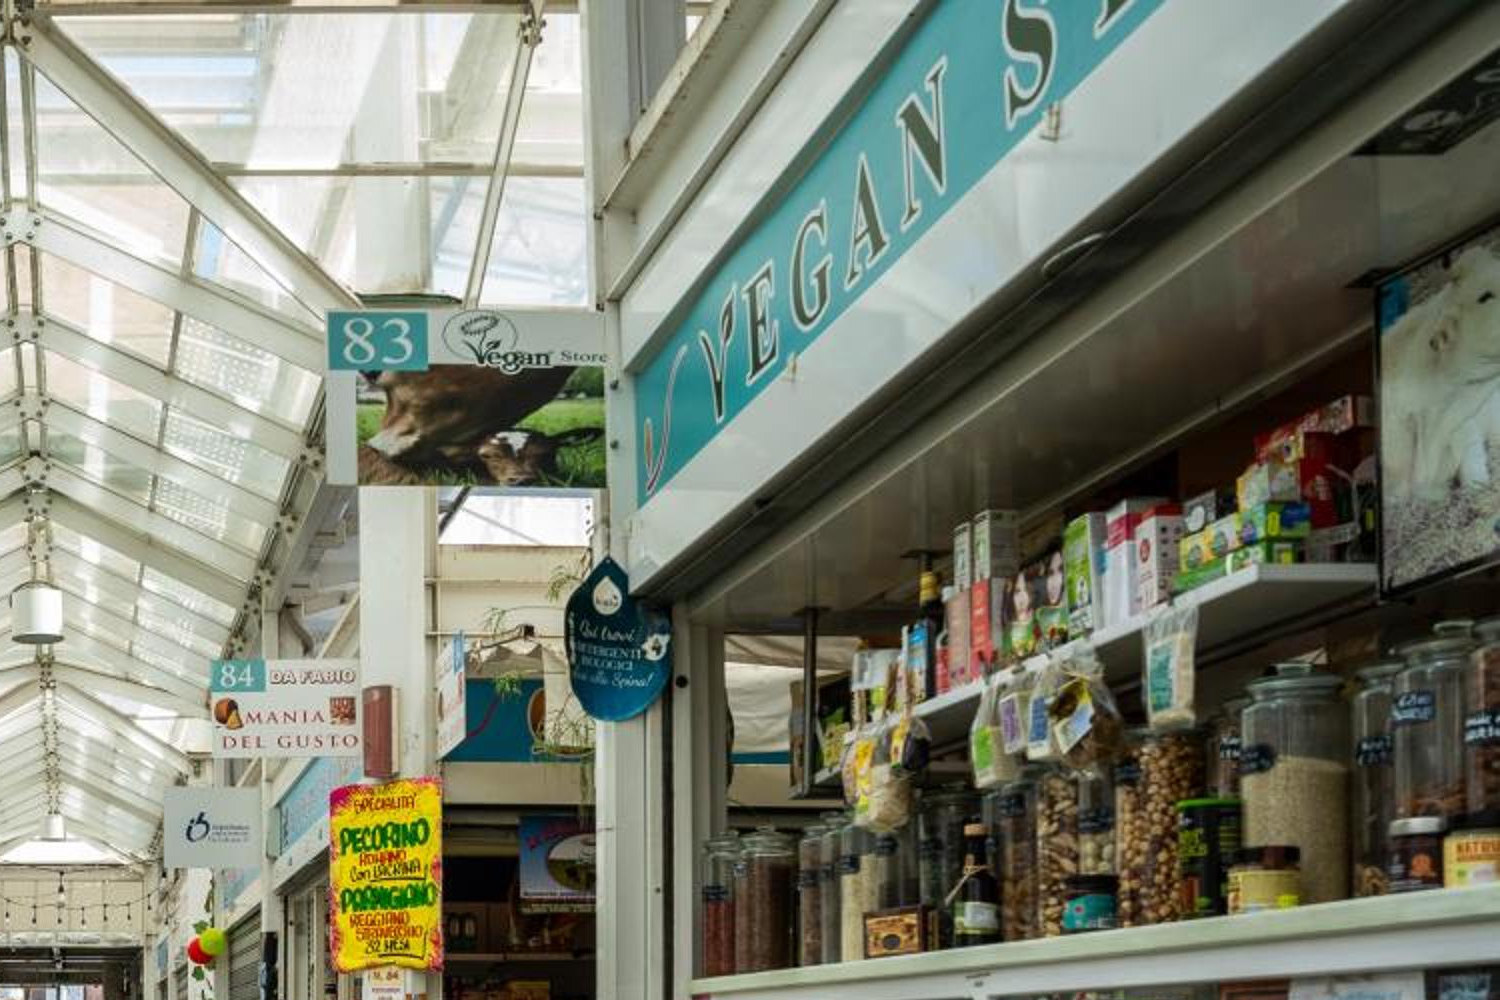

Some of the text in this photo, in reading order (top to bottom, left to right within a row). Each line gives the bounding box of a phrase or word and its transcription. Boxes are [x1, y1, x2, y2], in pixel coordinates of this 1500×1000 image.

[699, 55, 948, 424] VEGAN
[342, 317, 414, 366] 83
[461, 338, 607, 372] Vegan Store
[220, 663, 255, 689] 84
[270, 670, 356, 685] DA FABIO
[245, 710, 325, 724] MANIA
[222, 734, 359, 750] DEL GUSTO
[340, 817, 430, 856] PECORINO
[359, 851, 407, 867] ROMANO
[340, 882, 437, 914] PARMIGIANO
[350, 911, 411, 928] REGGIANO
